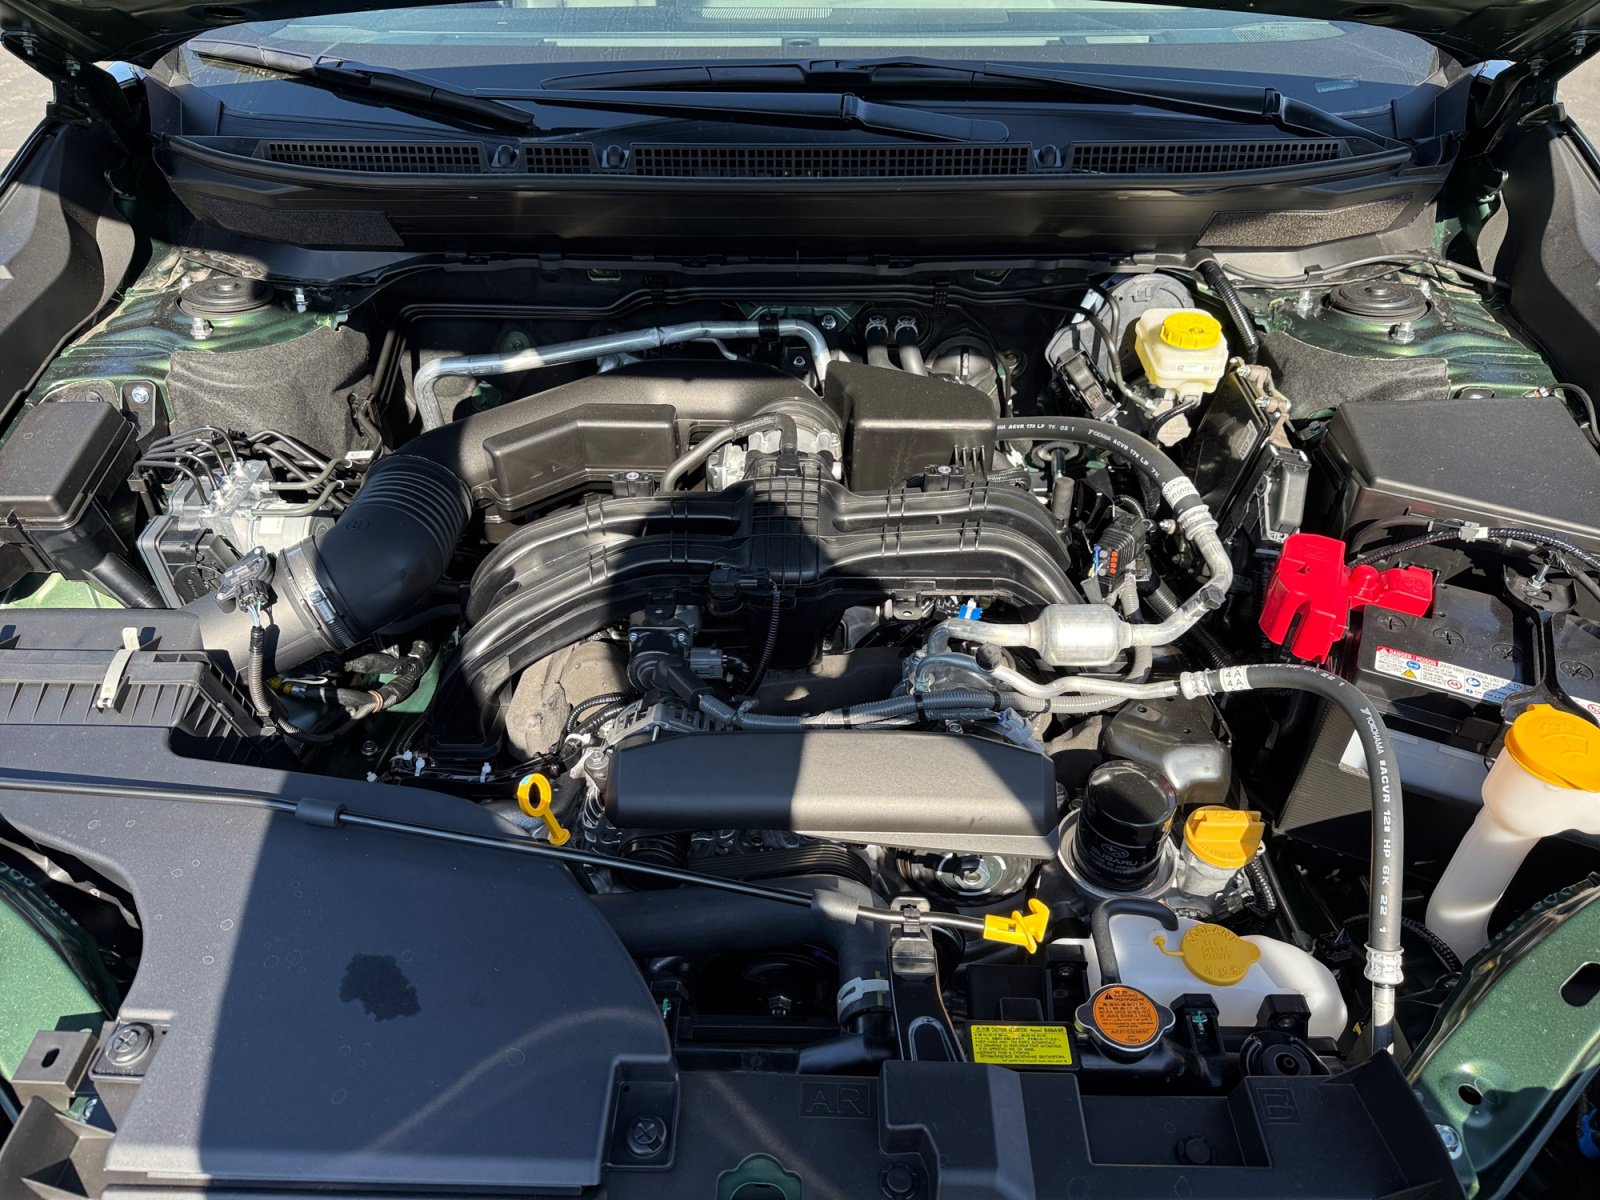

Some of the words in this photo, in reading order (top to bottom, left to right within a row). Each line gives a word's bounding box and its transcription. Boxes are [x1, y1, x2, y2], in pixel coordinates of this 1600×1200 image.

[1389, 648, 1412, 660] DANGER
[1416, 656, 1436, 666] POISON
[1366, 714, 1385, 755] YOKOHAMA
[1091, 846, 1138, 866] SUBARU
[1383, 839, 1391, 858] HP
[1382, 865, 1389, 886] 6K
[1380, 894, 1388, 915] 22
[1186, 924, 1237, 944] COOLANT
[806, 1086, 865, 1114] AR
